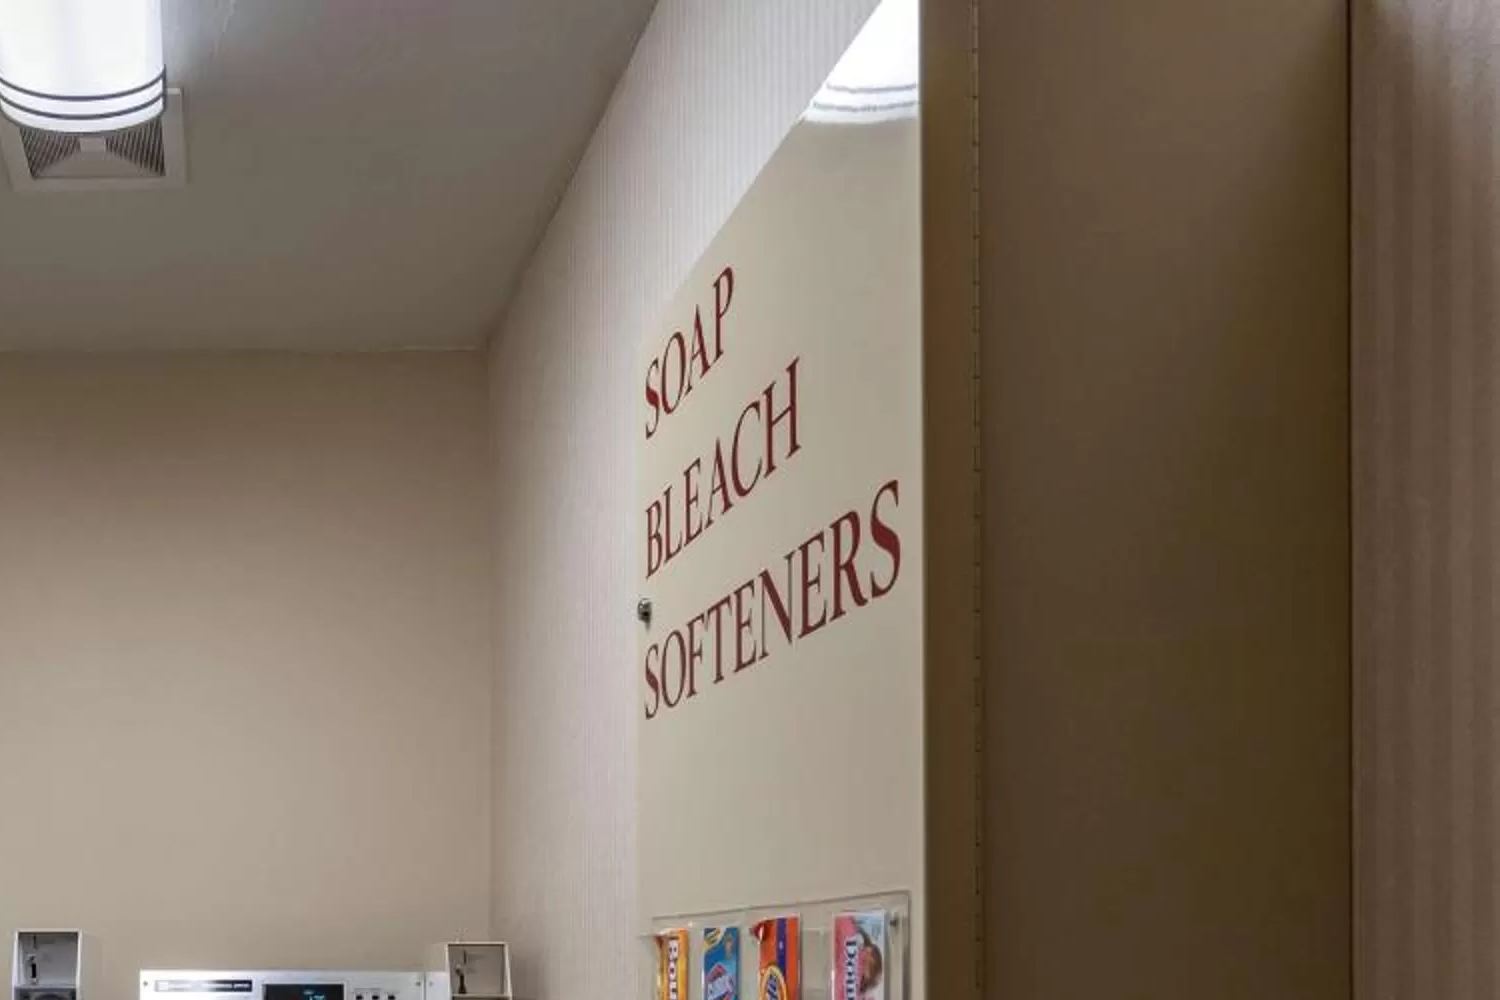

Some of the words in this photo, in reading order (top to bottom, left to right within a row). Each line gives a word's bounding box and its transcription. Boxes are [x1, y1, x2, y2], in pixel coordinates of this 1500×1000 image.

[645, 266, 735, 440] SOAP
[645, 356, 802, 580] BLEACH
[645, 479, 902, 720] SOFTENERS
